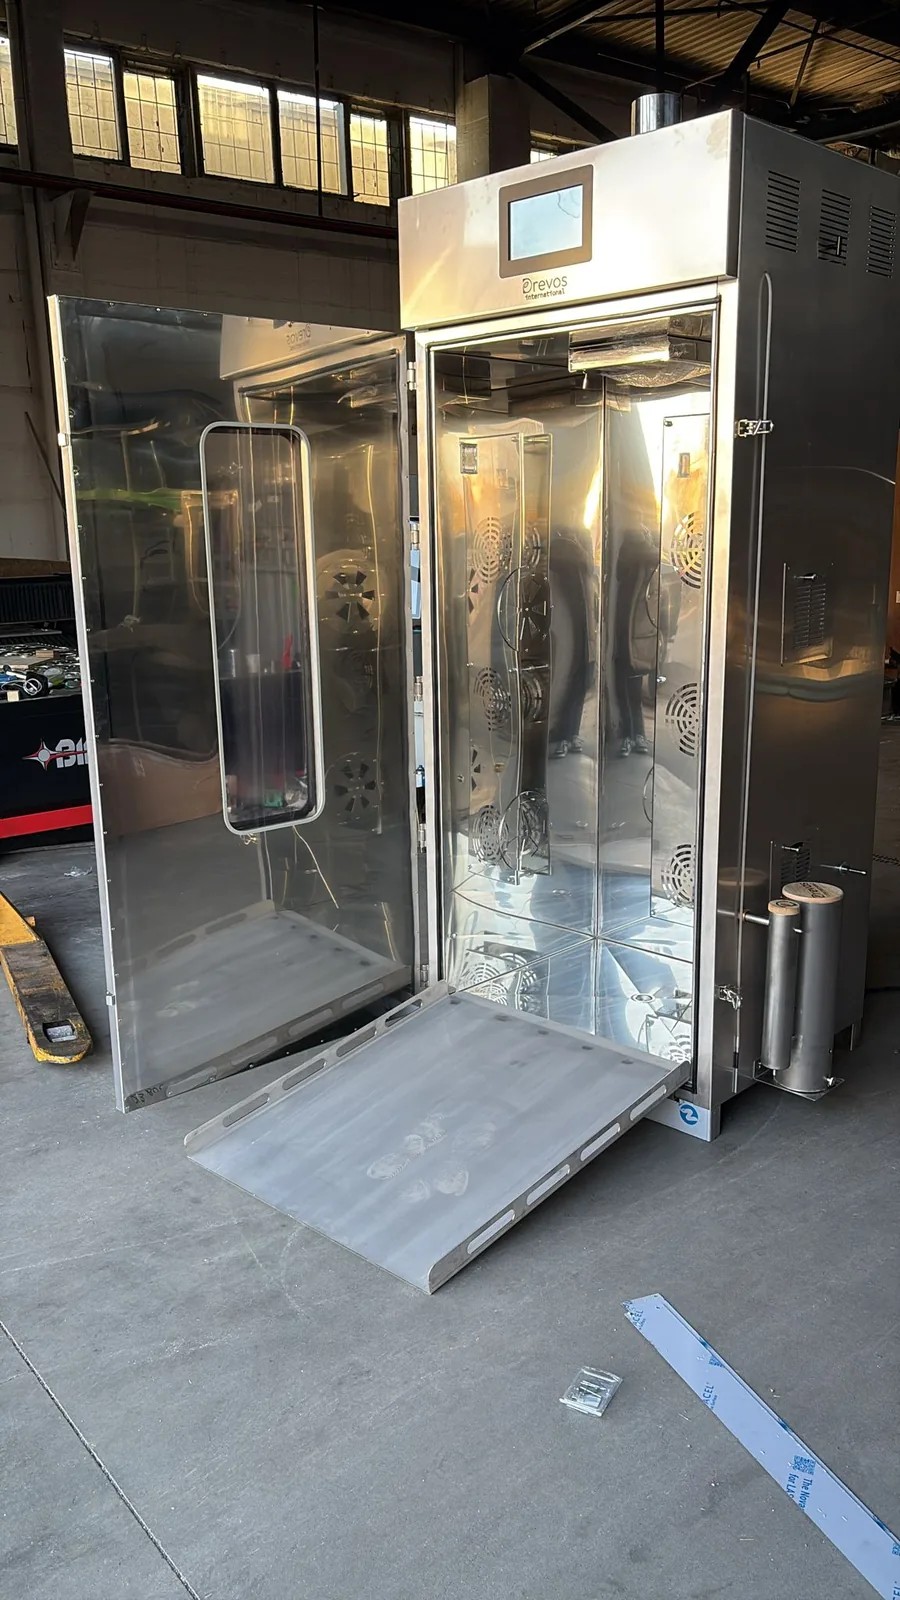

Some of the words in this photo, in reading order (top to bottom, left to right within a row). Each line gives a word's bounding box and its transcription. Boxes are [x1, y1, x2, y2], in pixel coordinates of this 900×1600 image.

[522, 276, 568, 294] Drevos
[788, 1473, 799, 1484] for
[801, 1478, 813, 1490] The
